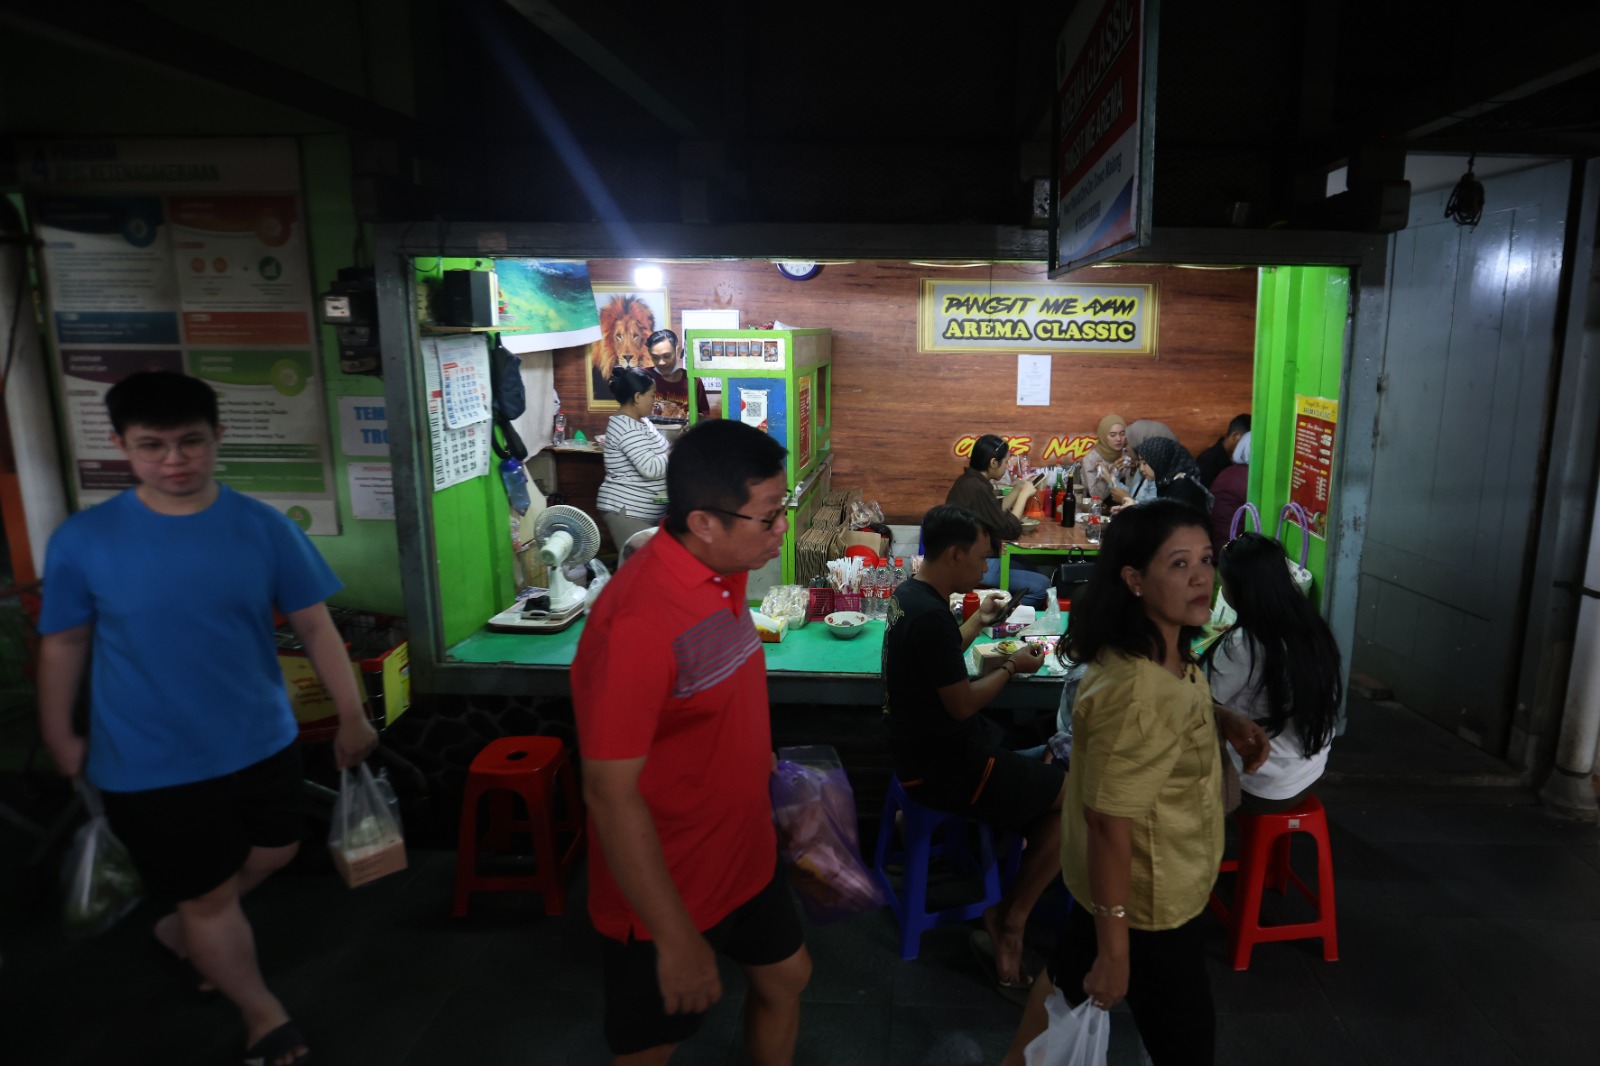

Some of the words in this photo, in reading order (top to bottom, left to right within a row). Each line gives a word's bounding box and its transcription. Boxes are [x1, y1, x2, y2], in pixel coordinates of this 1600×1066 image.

[1060, 63, 1087, 139] AREMA
[1087, 0, 1134, 94] CLASSIC
[1096, 76, 1123, 139] AREMA
[1105, 152, 1122, 179] Malang
[944, 296, 1036, 315] PANGSIT
[1039, 297, 1078, 316] MIE
[1082, 298, 1136, 316] AYAM
[943, 320, 1031, 340] AREMA
[1036, 320, 1133, 342] CLASSIC
